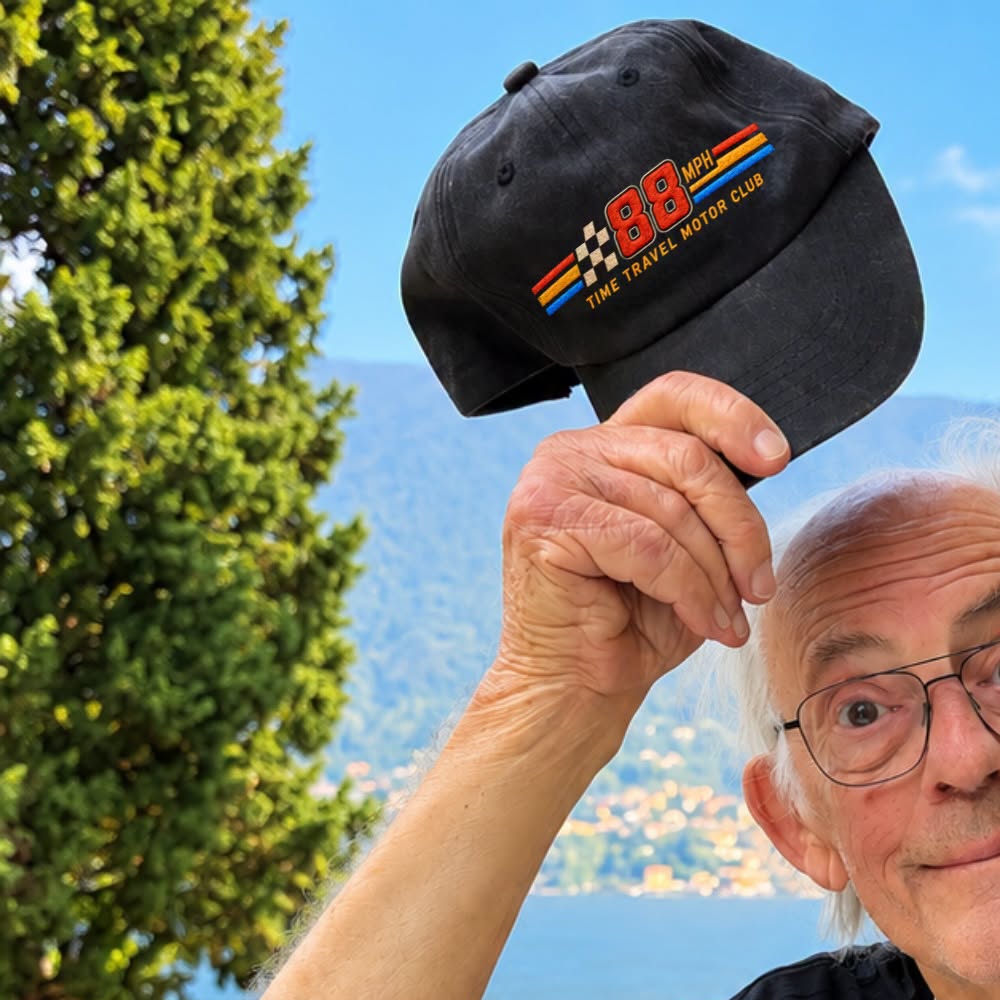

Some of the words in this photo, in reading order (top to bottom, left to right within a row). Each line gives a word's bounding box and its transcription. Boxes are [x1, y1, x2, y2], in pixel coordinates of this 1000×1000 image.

[585, 277, 621, 310] TIME
[622, 239, 678, 282] TRAVEL
[679, 199, 729, 241] MOTOR
[729, 172, 765, 204] CLUB
[604, 158, 694, 260] 88
[681, 149, 715, 184] MPH
